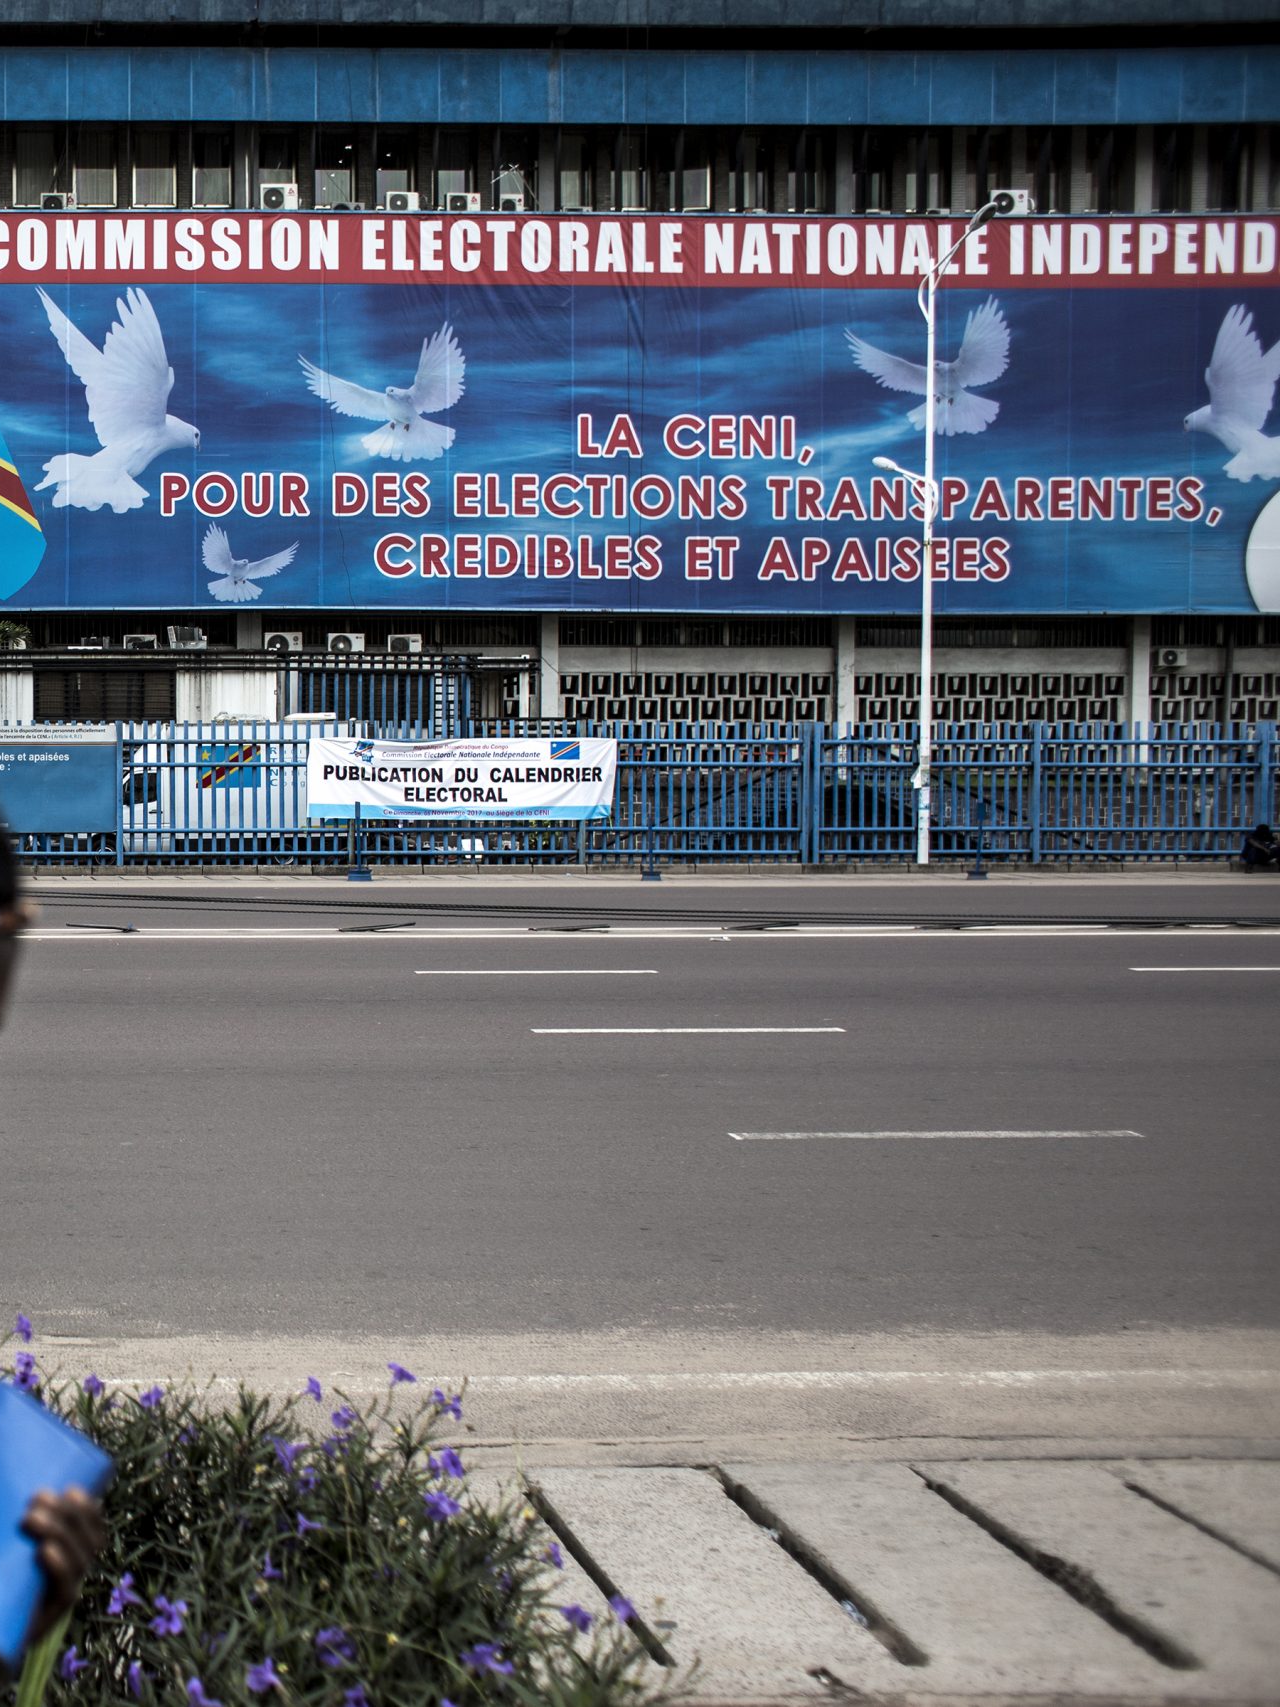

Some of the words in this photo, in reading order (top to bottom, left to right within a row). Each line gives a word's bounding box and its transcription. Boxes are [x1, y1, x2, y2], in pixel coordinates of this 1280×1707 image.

[361, 220, 684, 274] ELECTORALE
[703, 222, 989, 276] NATIONALE
[1008, 222, 1280, 275] INDEPEND
[576, 412, 644, 460] LA
[663, 413, 817, 467] CENI,
[160, 472, 311, 519] POUR
[331, 472, 432, 519] DES
[453, 473, 747, 521] ELECTIONS
[767, 475, 1224, 527] TRANSPARENTES,
[373, 532, 664, 581] CREDIBLES
[684, 535, 740, 581] ET
[757, 536, 1012, 584] APAISEES
[381, 751, 422, 759] Commission
[458, 751, 492, 759] Nationale
[492, 750, 540, 760] Indépendante
[490, 744, 509, 752] Congo
[17, 753, 27, 762] et
[28, 752, 70, 764] apaisées
[323, 764, 444, 783] PUBLICATION
[454, 765, 479, 783] DU
[489, 766, 603, 783] CALENDRIER
[403, 784, 508, 803] ELECTORAL
[496, 809, 514, 818] Siège
